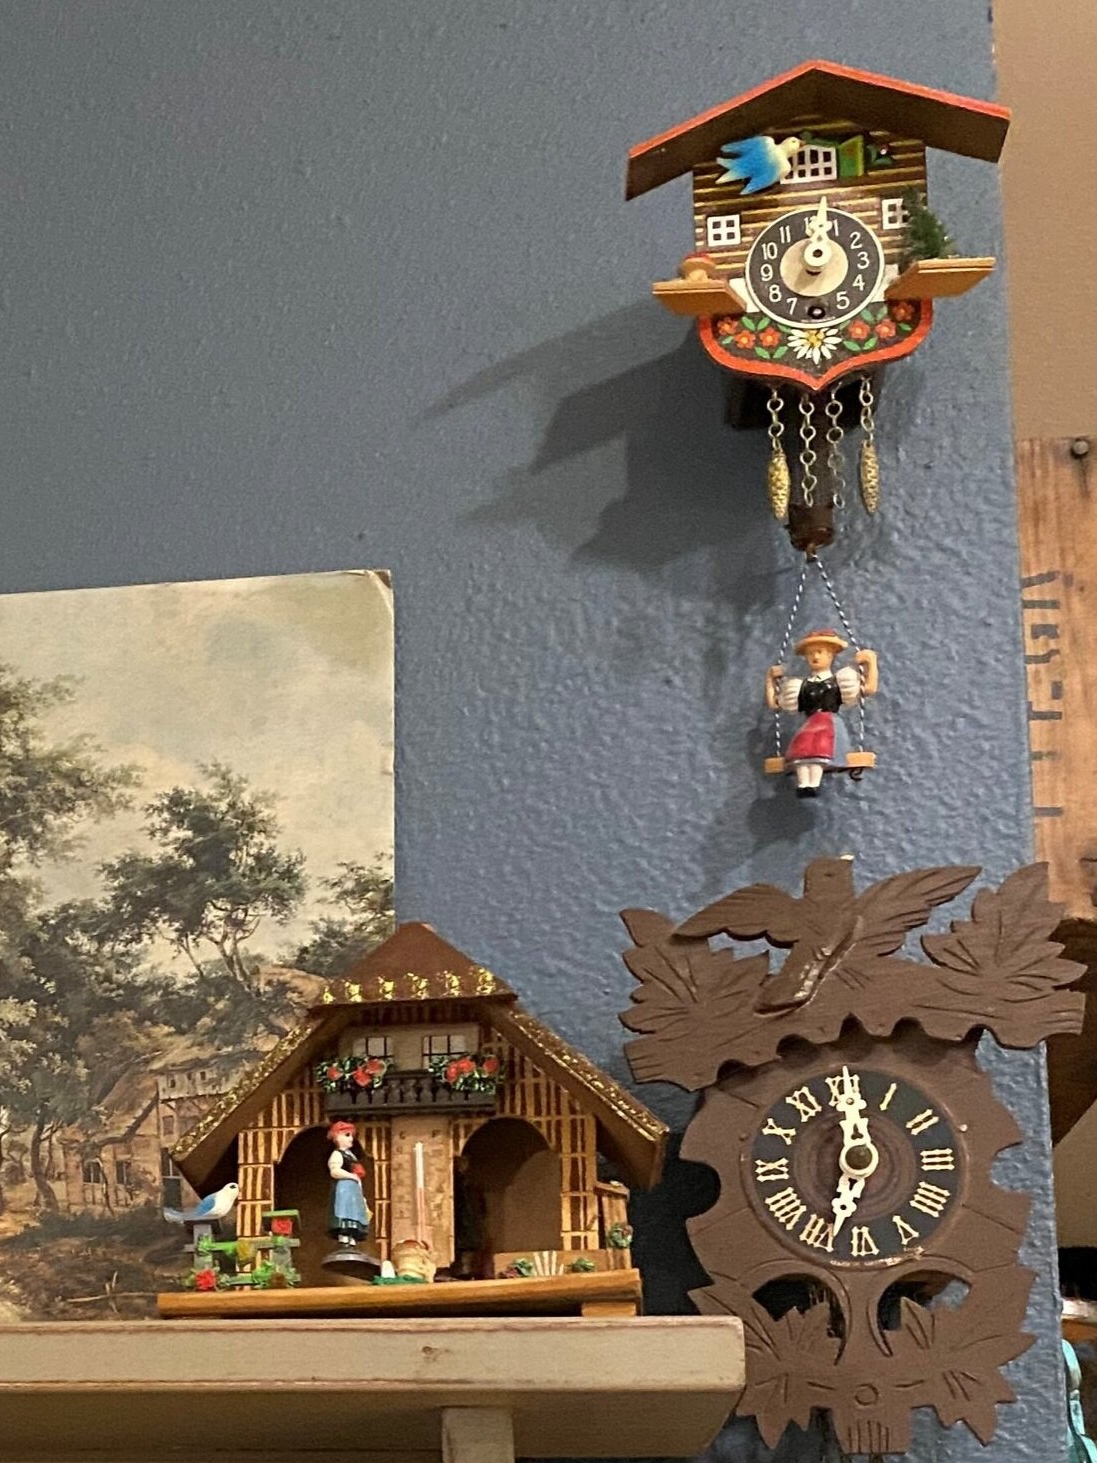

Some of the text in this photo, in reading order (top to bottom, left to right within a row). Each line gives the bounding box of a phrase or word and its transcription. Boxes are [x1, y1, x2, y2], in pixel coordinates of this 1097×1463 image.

[779, 225, 791, 243] 11
[832, 219, 839, 237] 1
[850, 231, 862, 249] 2
[761, 242, 778, 260] 10
[857, 251, 870, 269] 3
[760, 264, 773, 282] 9
[852, 274, 865, 291] 4
[769, 284, 782, 303] 8
[836, 291, 850, 310] 5
[786, 297, 798, 315] 7
[786, 1086, 822, 1122] XI
[880, 1083, 897, 1111] I
[905, 1109, 939, 1135] II
[762, 1118, 796, 1145] X
[920, 1148, 954, 1171] III
[892, 1215, 919, 1245] V
